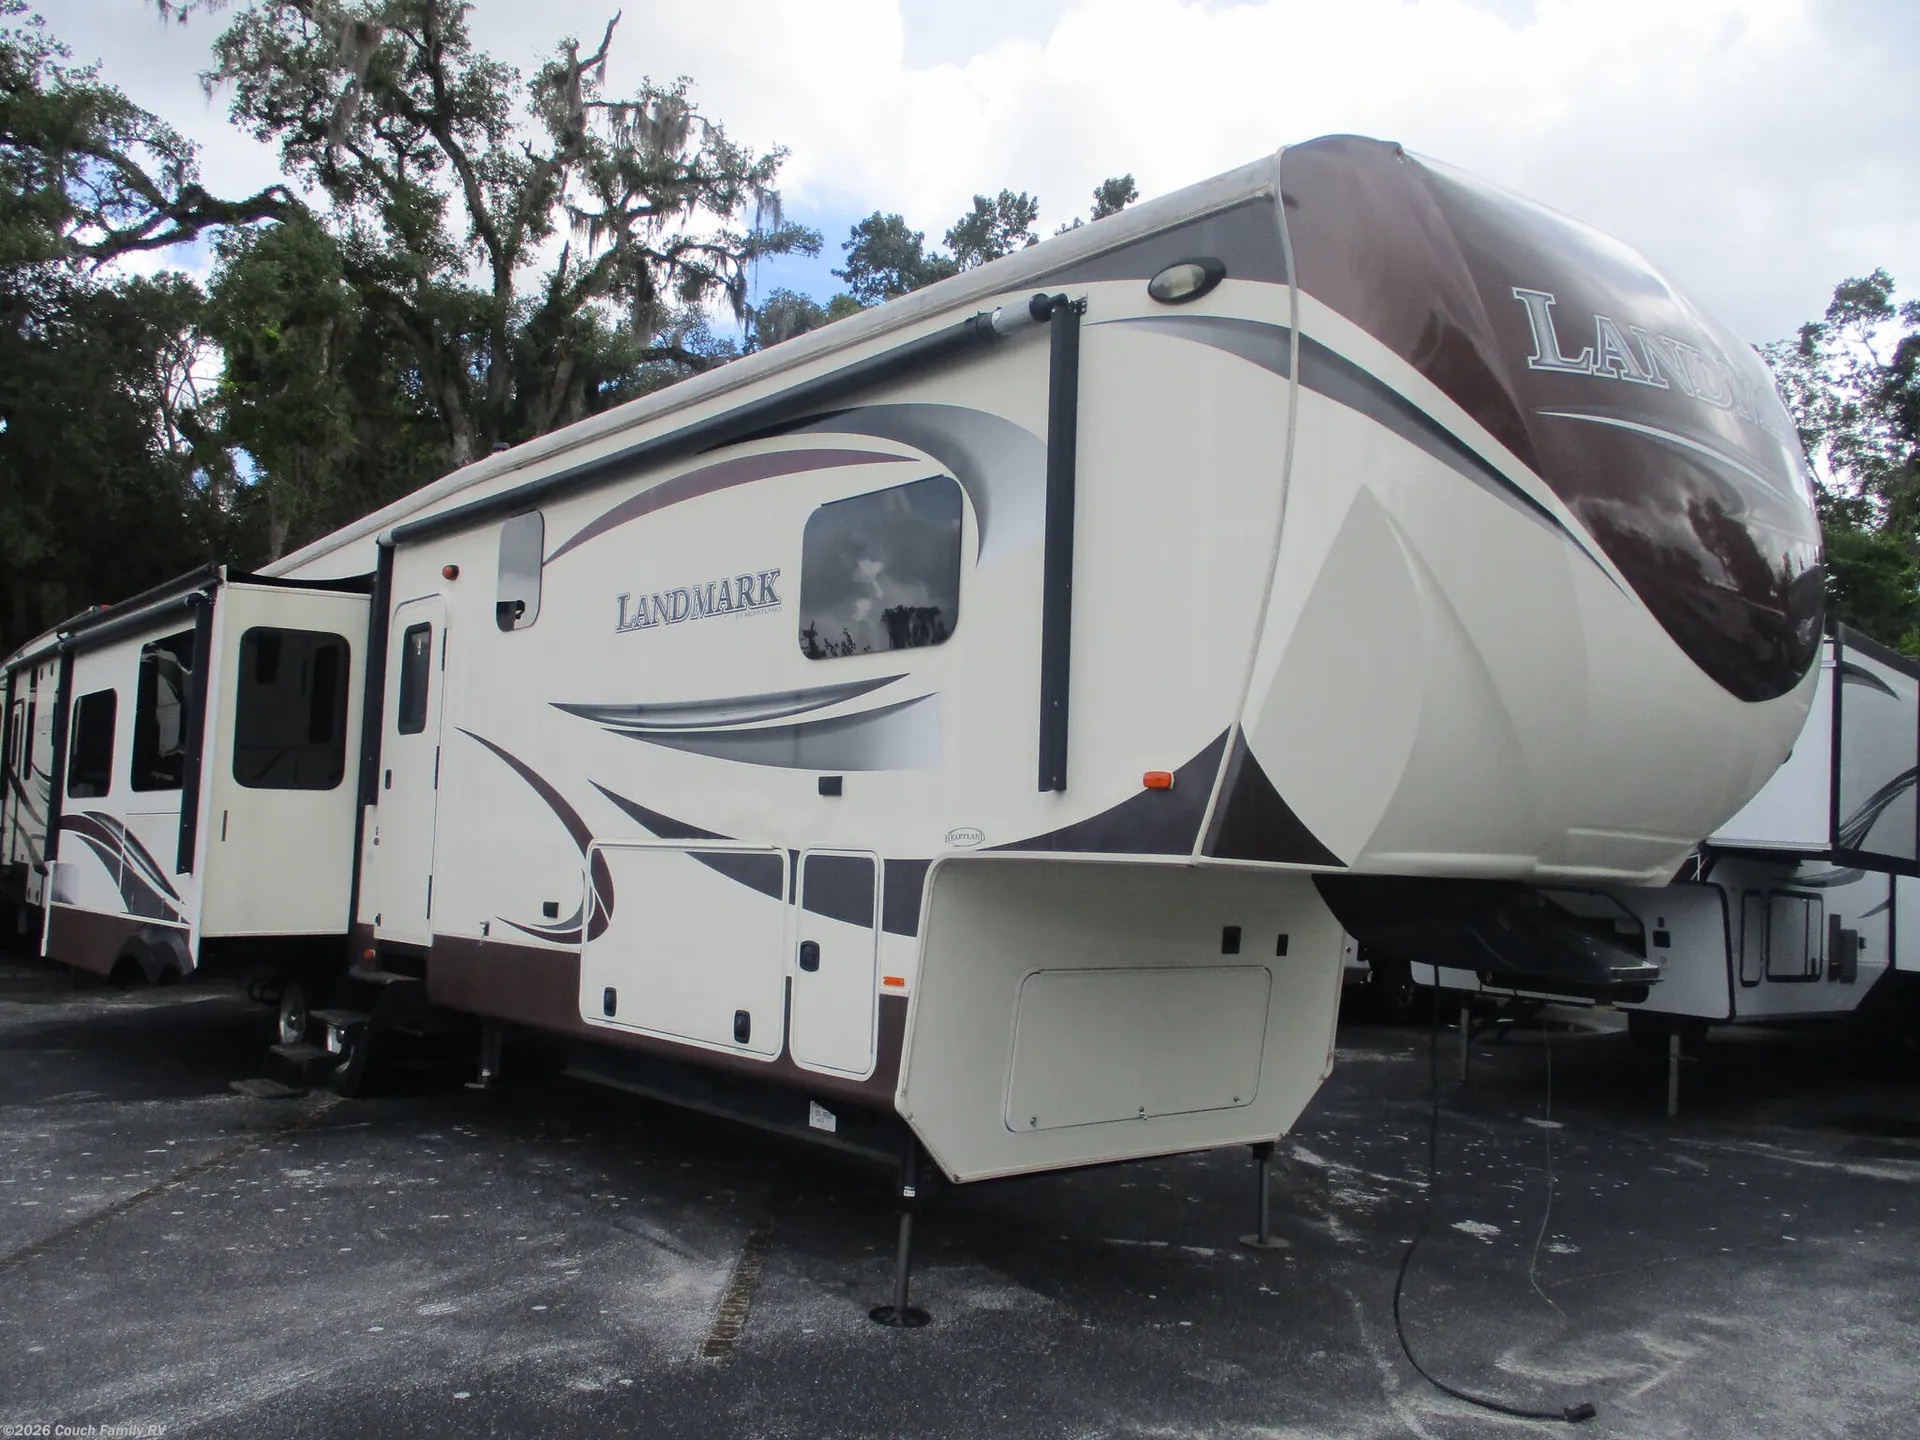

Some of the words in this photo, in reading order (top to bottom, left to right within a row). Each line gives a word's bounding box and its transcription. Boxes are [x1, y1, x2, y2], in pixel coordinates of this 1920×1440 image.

[1511, 286, 1787, 437] LAND
[615, 568, 781, 633] LANDMARK
[944, 832, 986, 843] HEARTLAND
